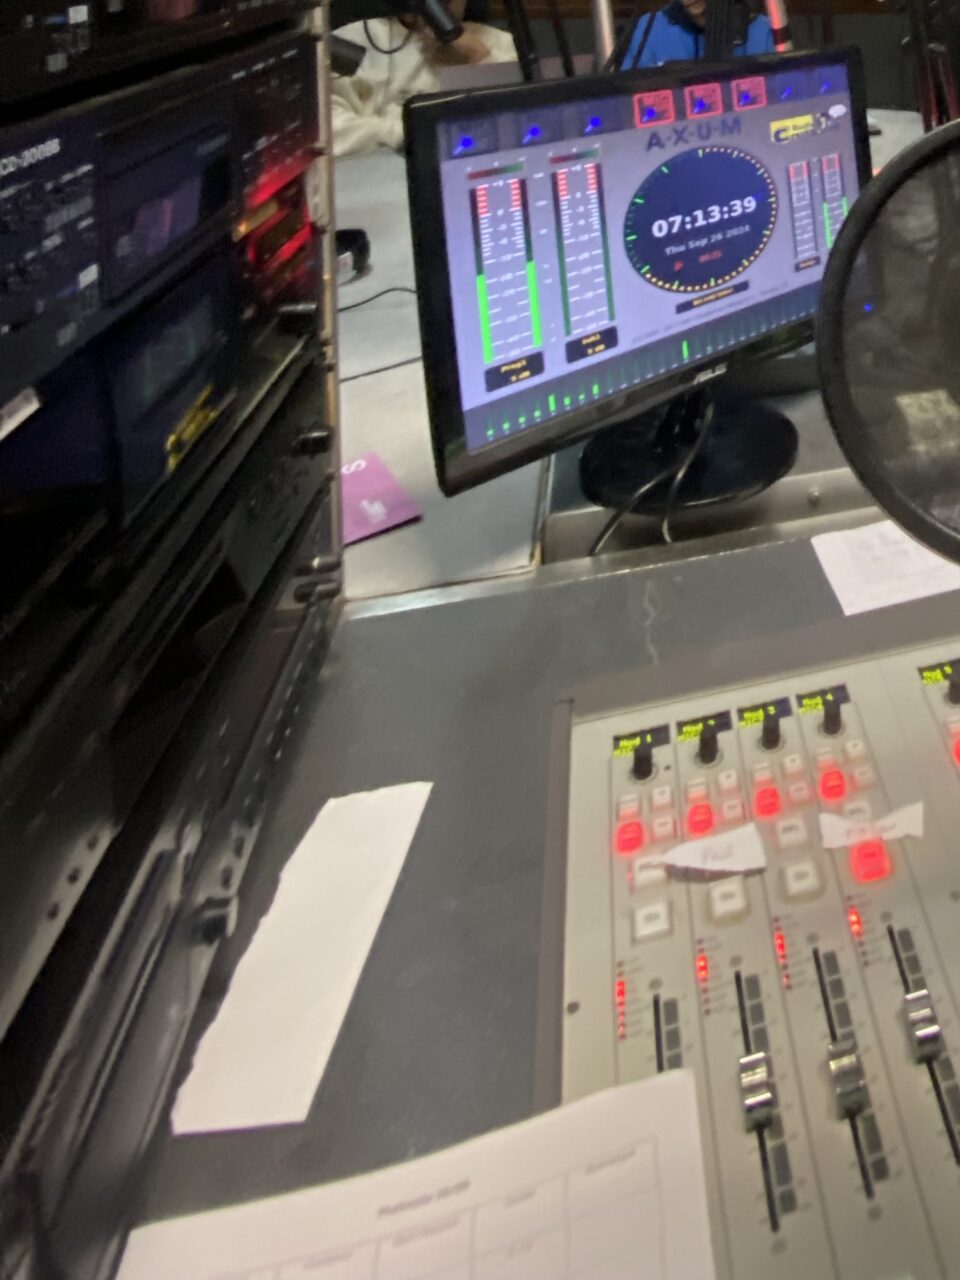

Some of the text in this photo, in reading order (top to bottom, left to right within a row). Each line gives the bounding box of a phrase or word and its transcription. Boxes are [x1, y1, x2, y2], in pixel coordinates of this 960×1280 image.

[651, 195, 757, 238] 07:13:39
[665, 241, 686, 257] Thu
[688, 234, 709, 249] Sep
